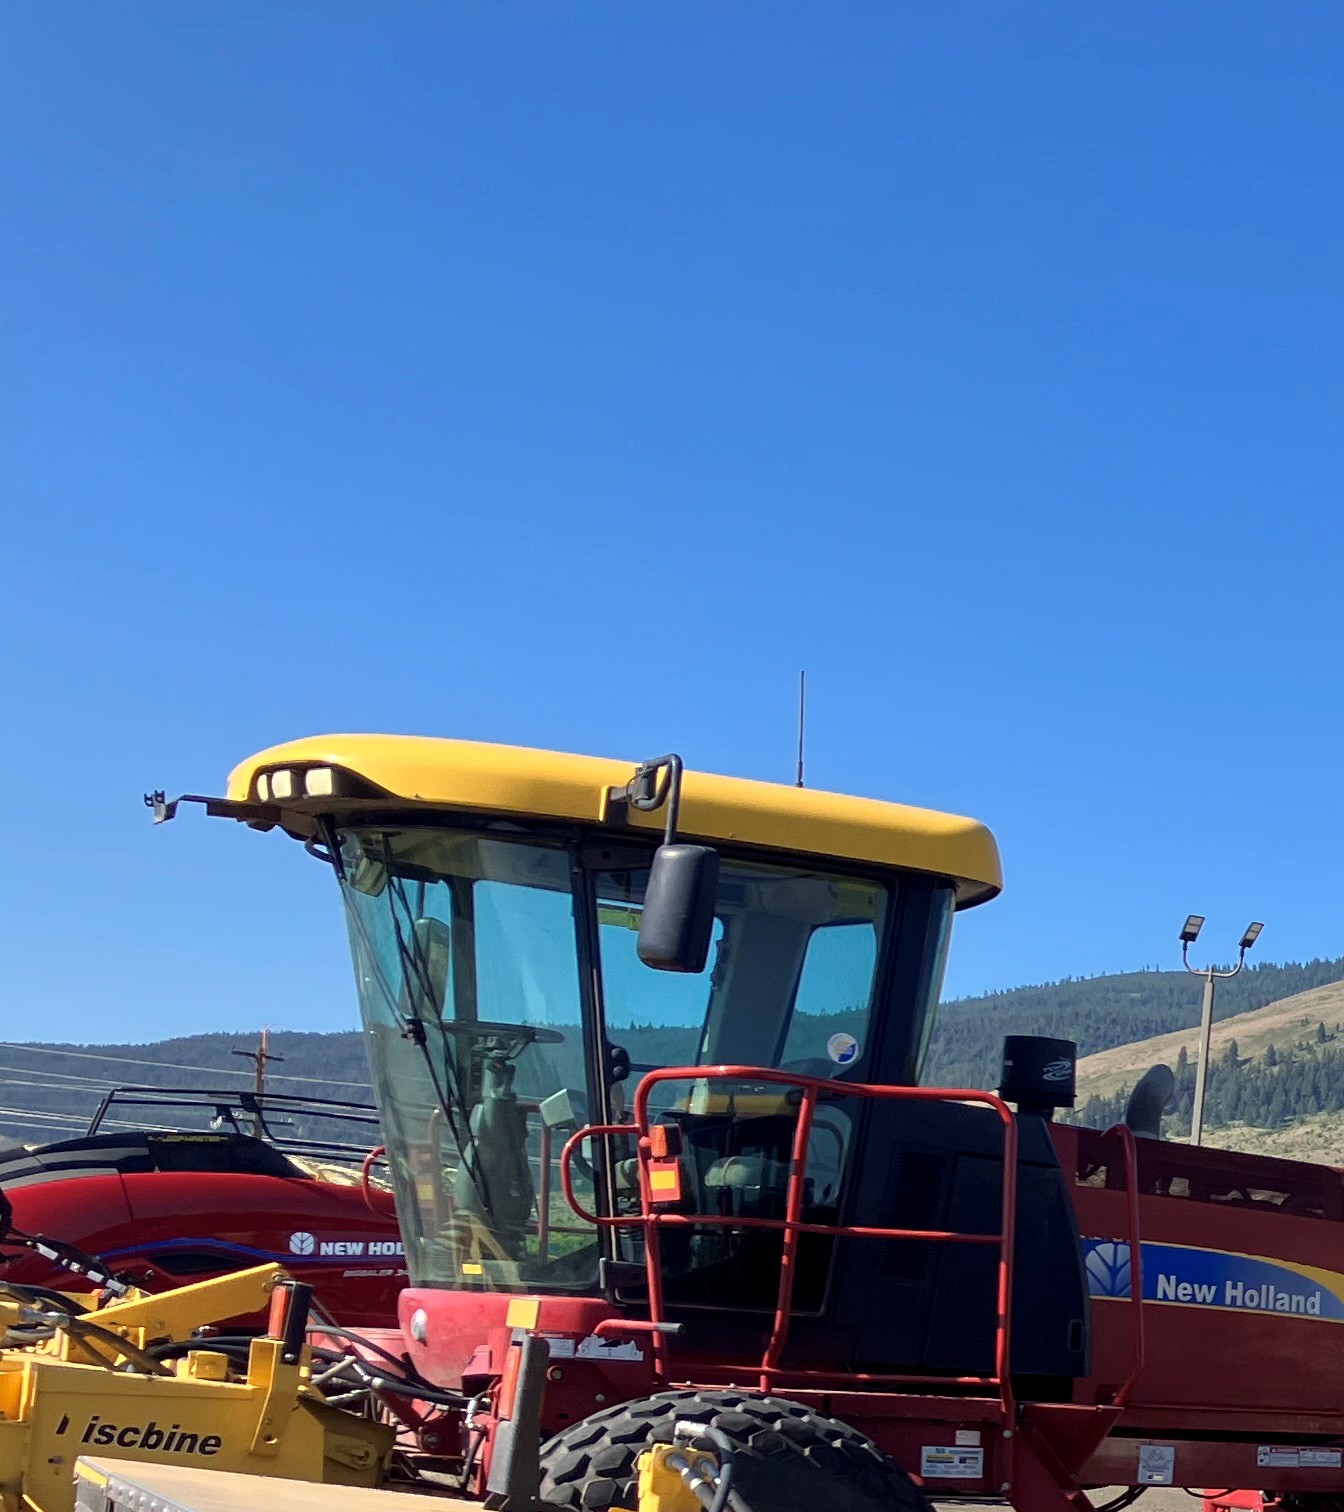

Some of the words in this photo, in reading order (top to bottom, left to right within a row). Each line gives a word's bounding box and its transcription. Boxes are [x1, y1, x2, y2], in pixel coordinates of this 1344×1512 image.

[320, 1242, 366, 1256] NEW
[368, 1242, 406, 1256] HOL
[1157, 1274, 1217, 1303] New
[1225, 1280, 1322, 1316] Holland
[55, 1412, 223, 1457] iscbine
